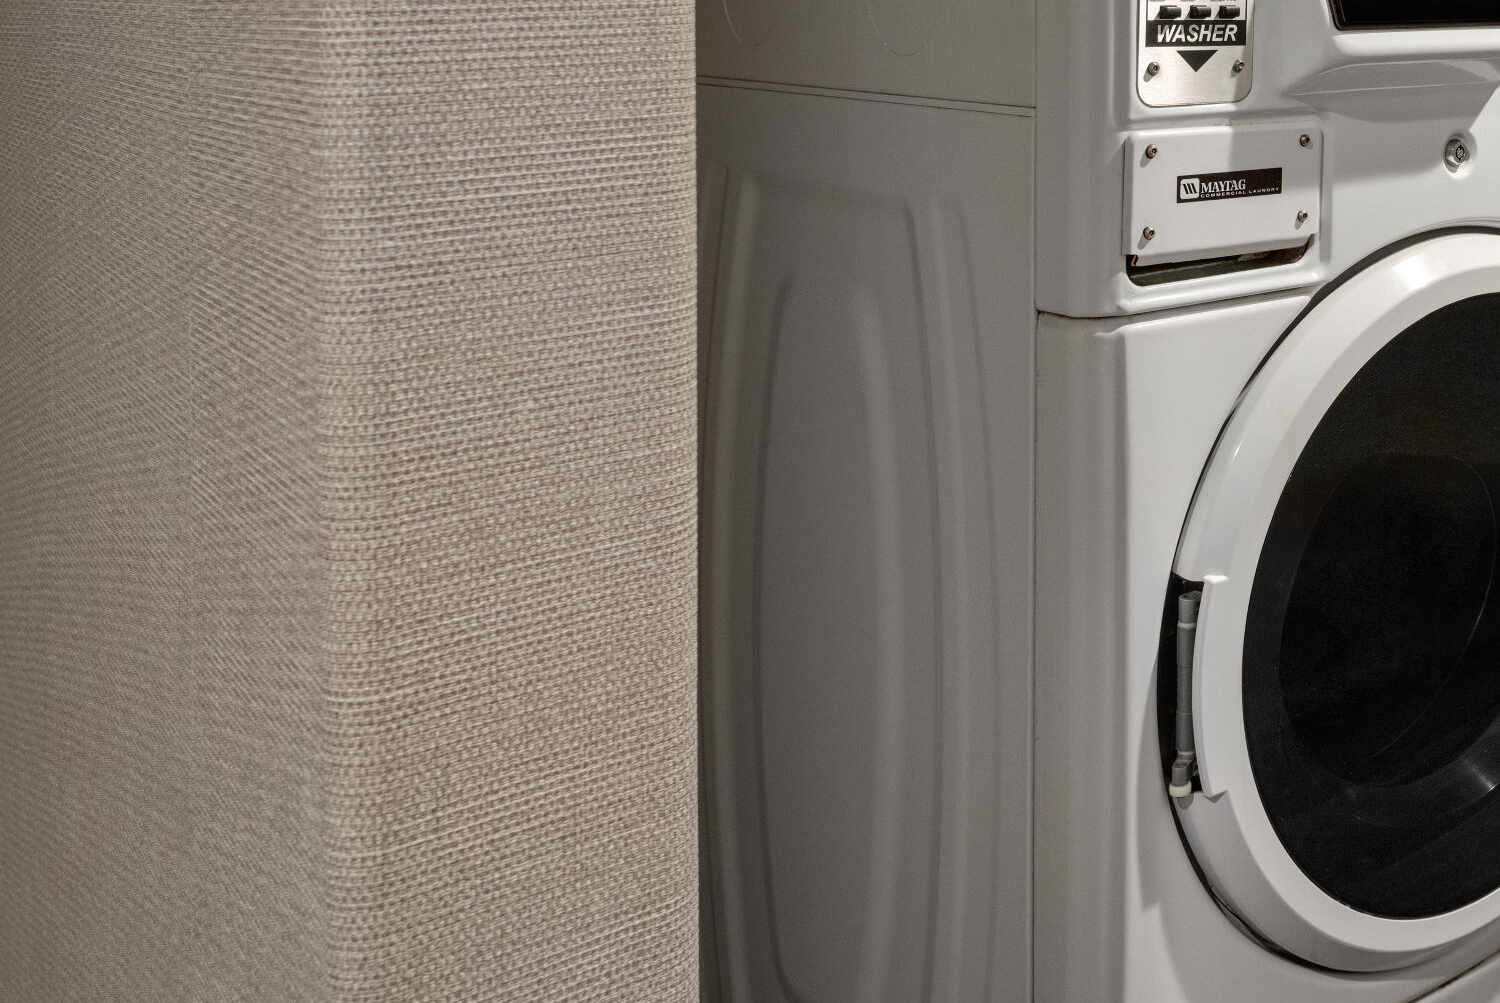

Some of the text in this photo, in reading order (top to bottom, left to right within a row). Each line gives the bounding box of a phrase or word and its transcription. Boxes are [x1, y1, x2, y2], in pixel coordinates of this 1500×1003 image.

[1157, 24, 1238, 43] WASHER
[1200, 179, 1246, 194] MAYTAG
[1200, 190, 1246, 199] COMMERCIAL
